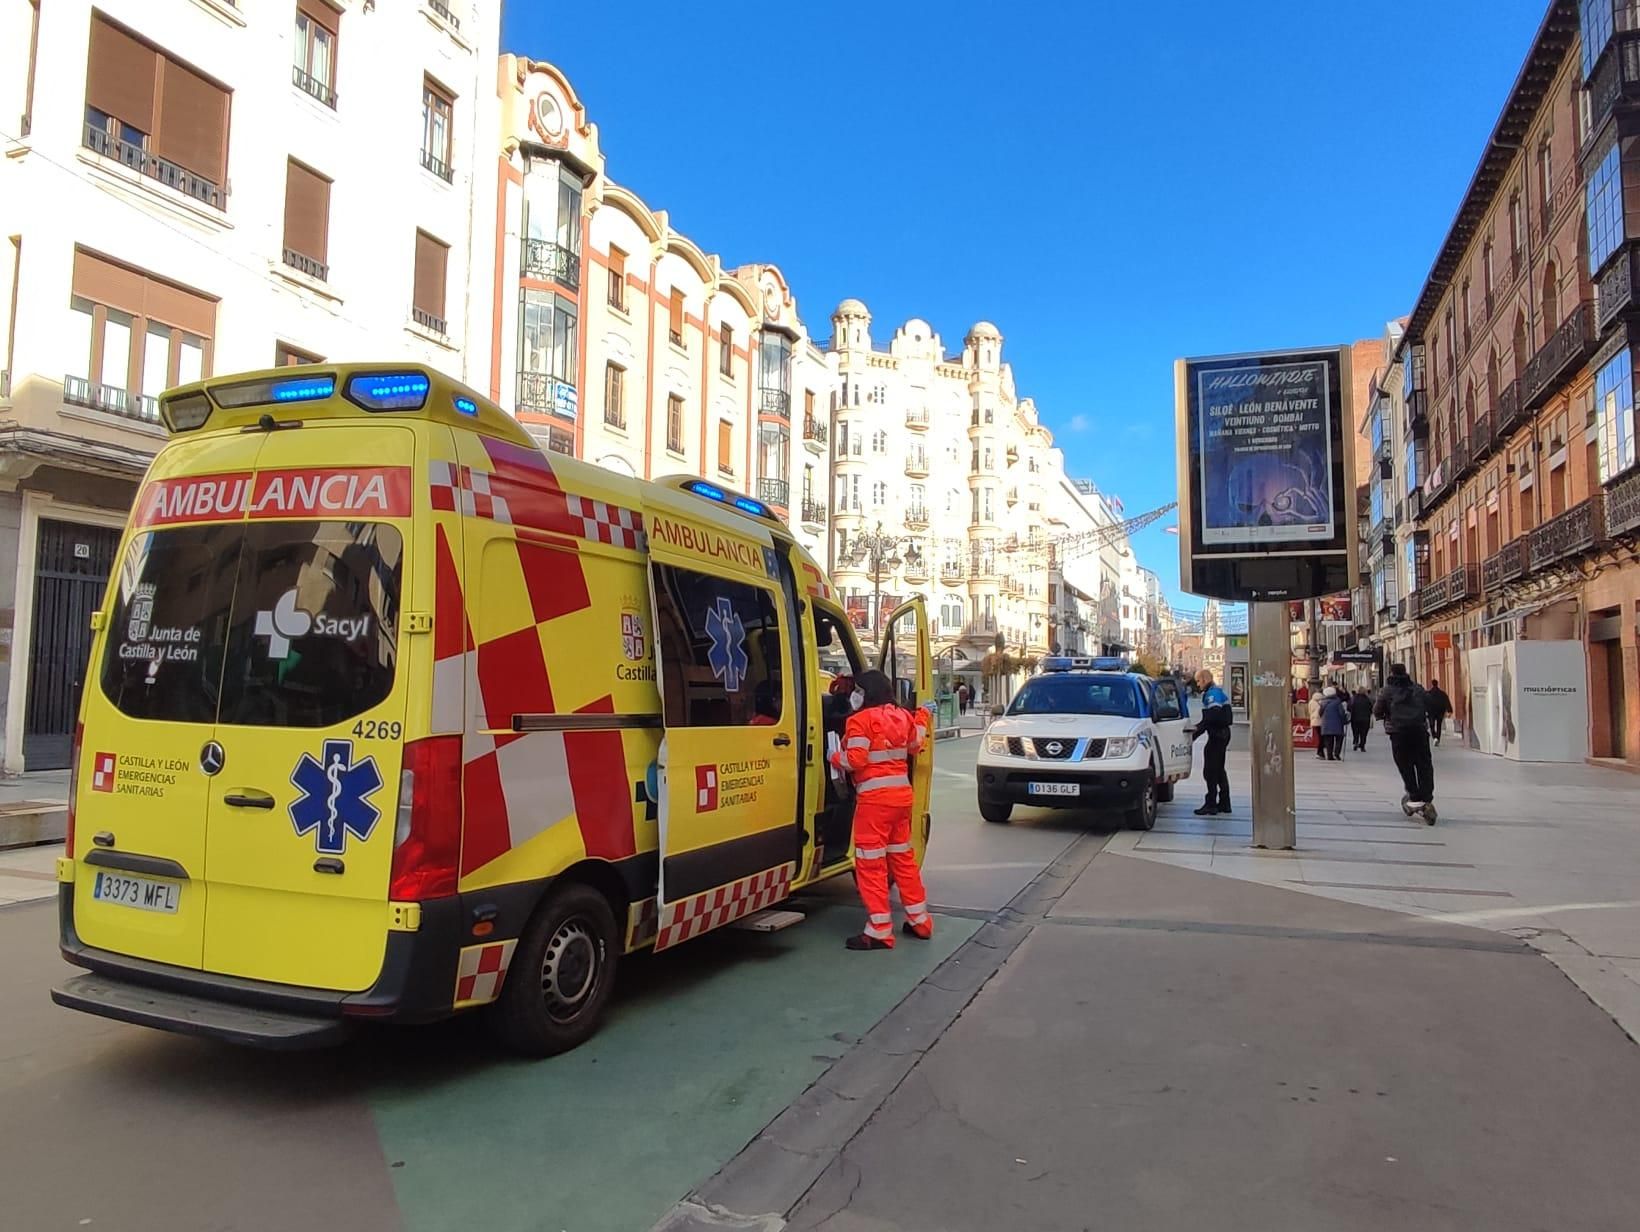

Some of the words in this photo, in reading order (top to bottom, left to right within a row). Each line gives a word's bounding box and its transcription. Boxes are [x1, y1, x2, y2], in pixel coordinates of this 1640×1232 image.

[1208, 369, 1317, 389] HALLOWINDIE
[1240, 401, 1262, 414] LEÓN
[1265, 399, 1318, 412] BENAVENTE
[149, 474, 389, 518] AMBULANCIA
[76, 544, 87, 556] 20
[652, 517, 762, 569] AMBULANCIA
[148, 626, 182, 642] Junta
[185, 626, 201, 641] de
[313, 614, 369, 641] Sacyl
[119, 643, 155, 660] Castilla
[156, 648, 165, 662] y
[167, 644, 197, 661] León
[616, 664, 657, 681] Castilla
[352, 720, 402, 740] 4269
[119, 755, 156, 769] CASTILLA
[157, 759, 163, 769] Y
[164, 759, 190, 772] LEÓN
[719, 763, 749, 775] CASTILLA
[755, 757, 770, 769] LEÓN
[118, 769, 176, 785] EMERGENCIAS
[721, 775, 765, 791] EMERGENCIAS
[116, 783, 164, 798] SANITARIAS
[1034, 784, 1058, 795] 0136
[1060, 784, 1078, 795] GLF
[720, 791, 758, 808] SANITARIAS
[103, 877, 139, 902] 3373
[144, 887, 174, 910] MFL
